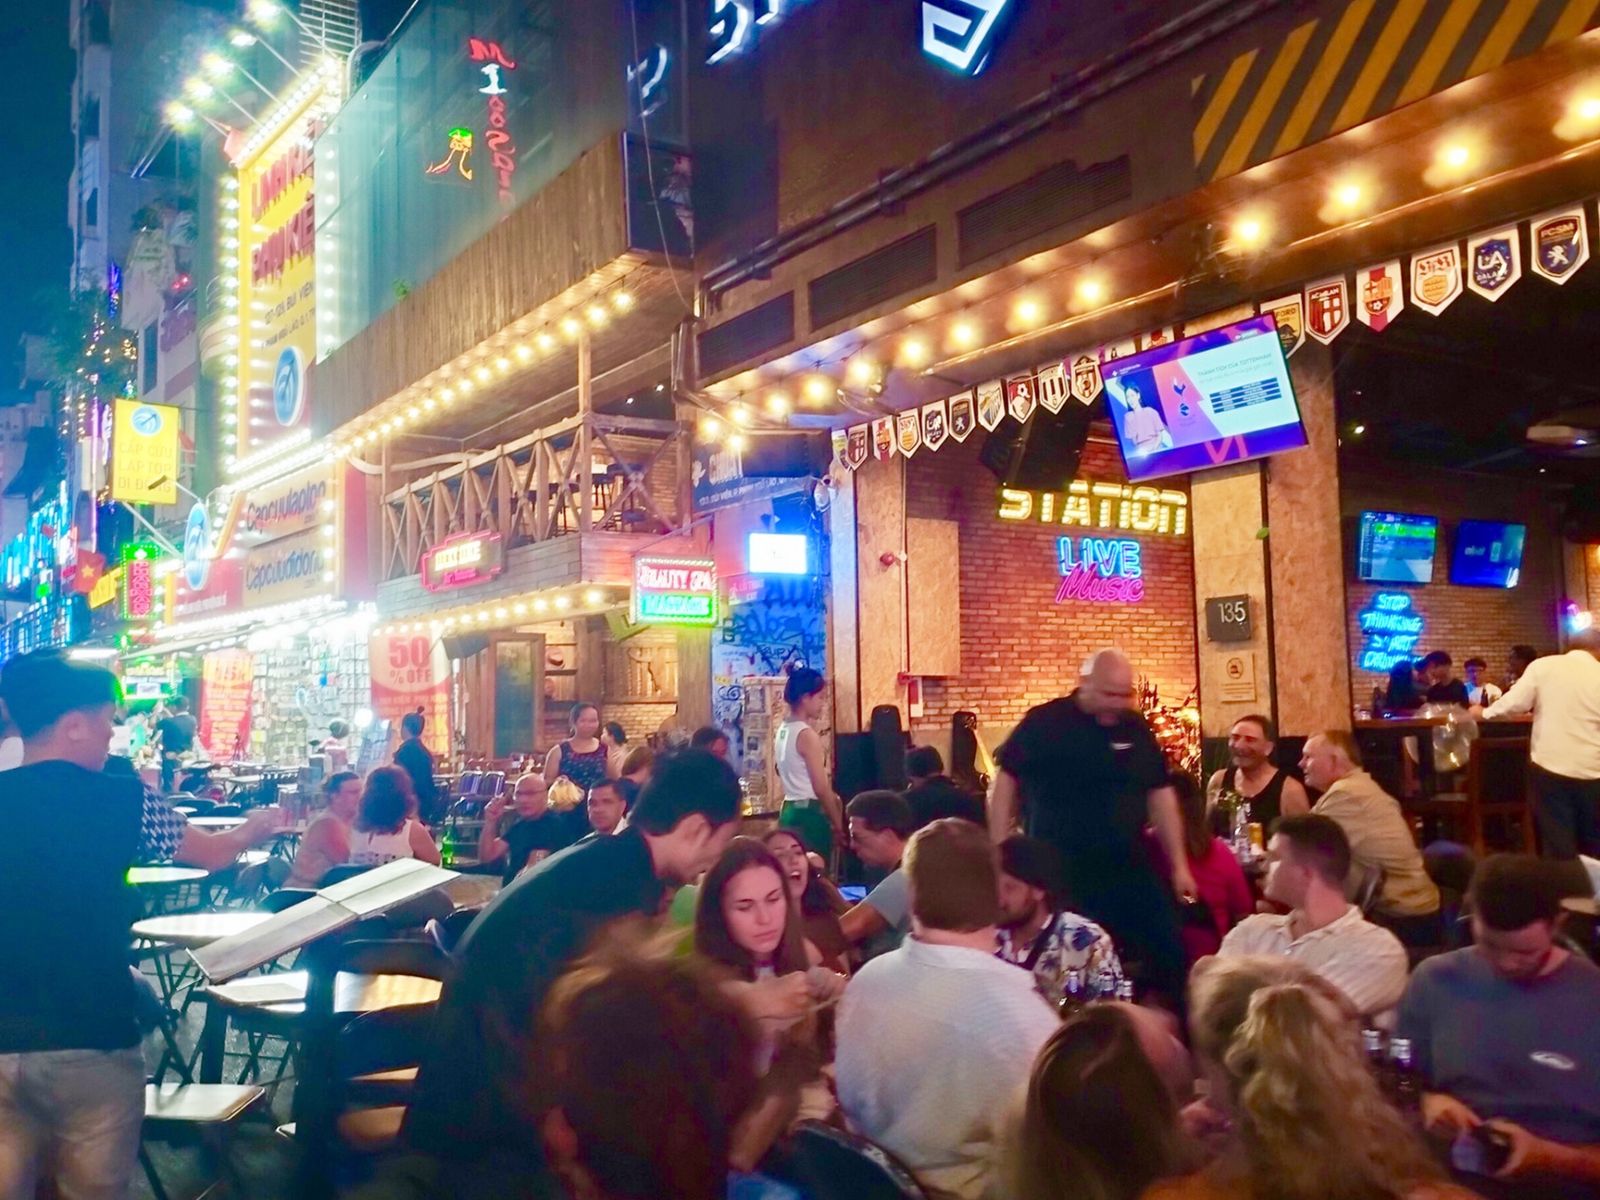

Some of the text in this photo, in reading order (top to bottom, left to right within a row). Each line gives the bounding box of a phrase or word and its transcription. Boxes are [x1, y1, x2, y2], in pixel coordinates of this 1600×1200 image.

[1059, 536, 1142, 578] LIVE
[690, 571, 712, 591] SPA
[1055, 560, 1144, 603] Music
[1218, 601, 1246, 623] 135
[1378, 594, 1408, 610] STOP
[389, 636, 430, 669] 50
[407, 669, 432, 684] OFF
